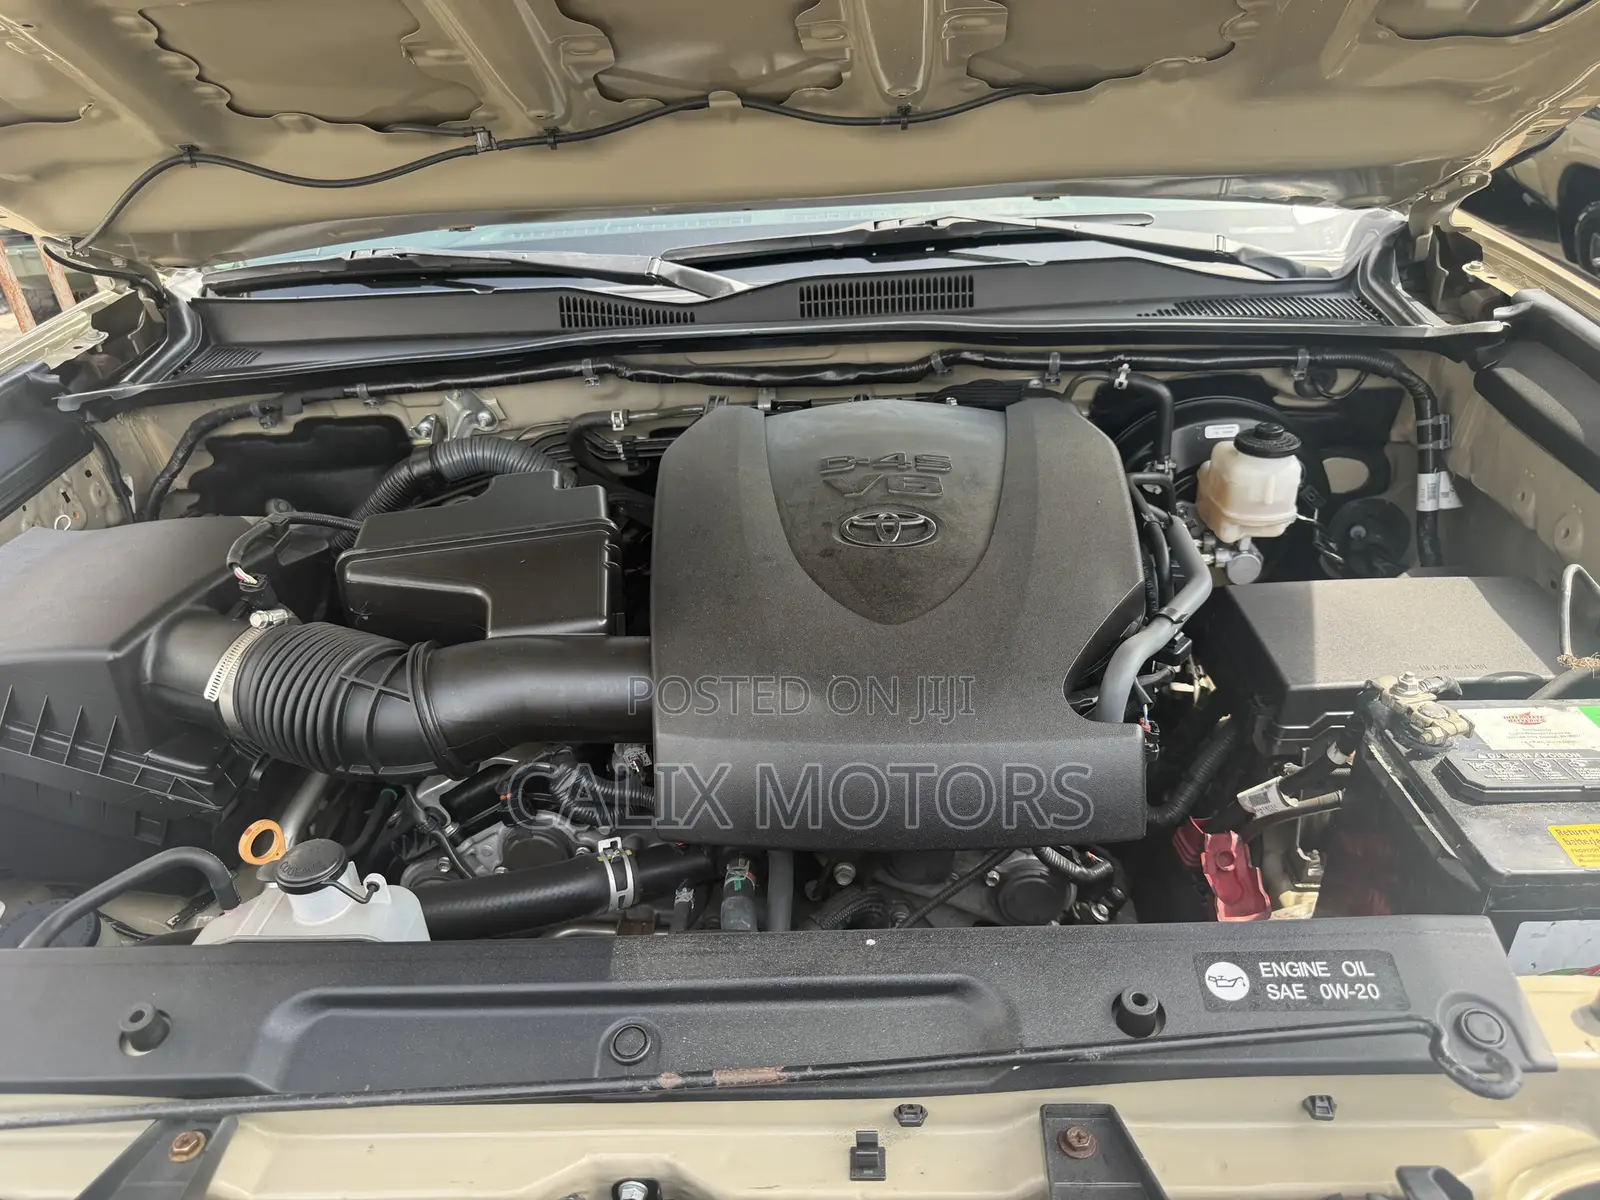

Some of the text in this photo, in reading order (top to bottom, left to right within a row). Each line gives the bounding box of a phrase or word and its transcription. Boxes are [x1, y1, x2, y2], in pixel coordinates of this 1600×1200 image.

[820, 451, 952, 475] D-4S
[822, 473, 944, 497] V6
[1554, 828, 1590, 836] Return
[1258, 961, 1375, 977] ENGINE OIL
[1266, 983, 1380, 1000] SAE 0W-20
